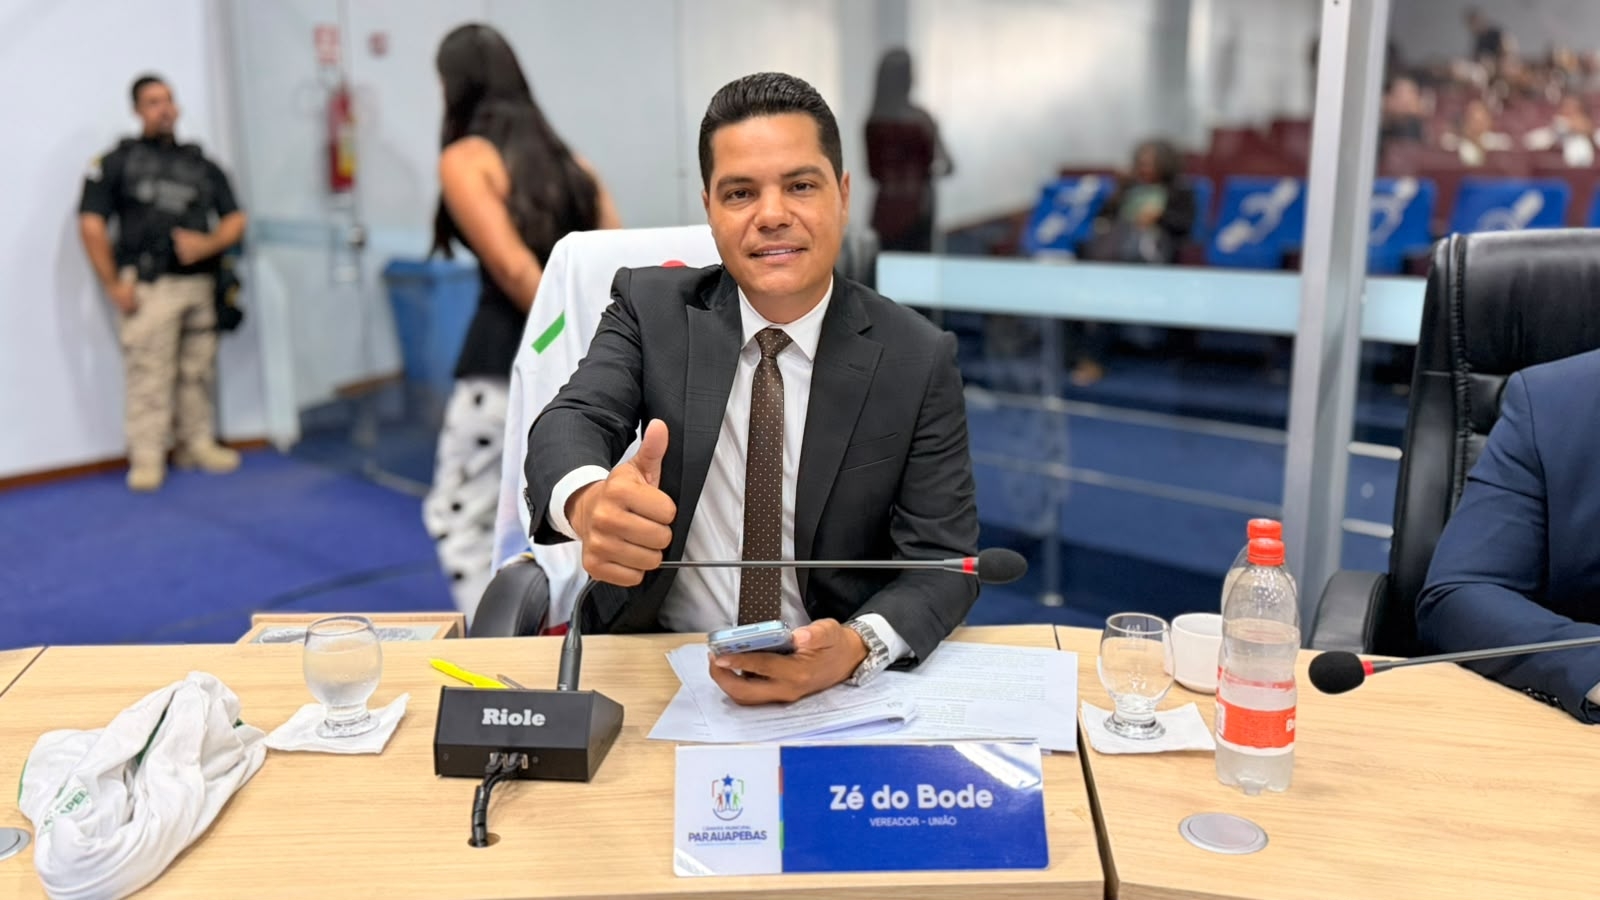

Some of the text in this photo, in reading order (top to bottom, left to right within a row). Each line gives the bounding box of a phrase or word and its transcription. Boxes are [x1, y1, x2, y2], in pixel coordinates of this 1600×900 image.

[481, 708, 546, 726] Riole
[829, 784, 994, 811] Zé do Bode
[869, 816, 920, 827] VEREADOR
[928, 815, 957, 826] UNIÃO
[688, 830, 767, 841] PARAUAPEBAS
